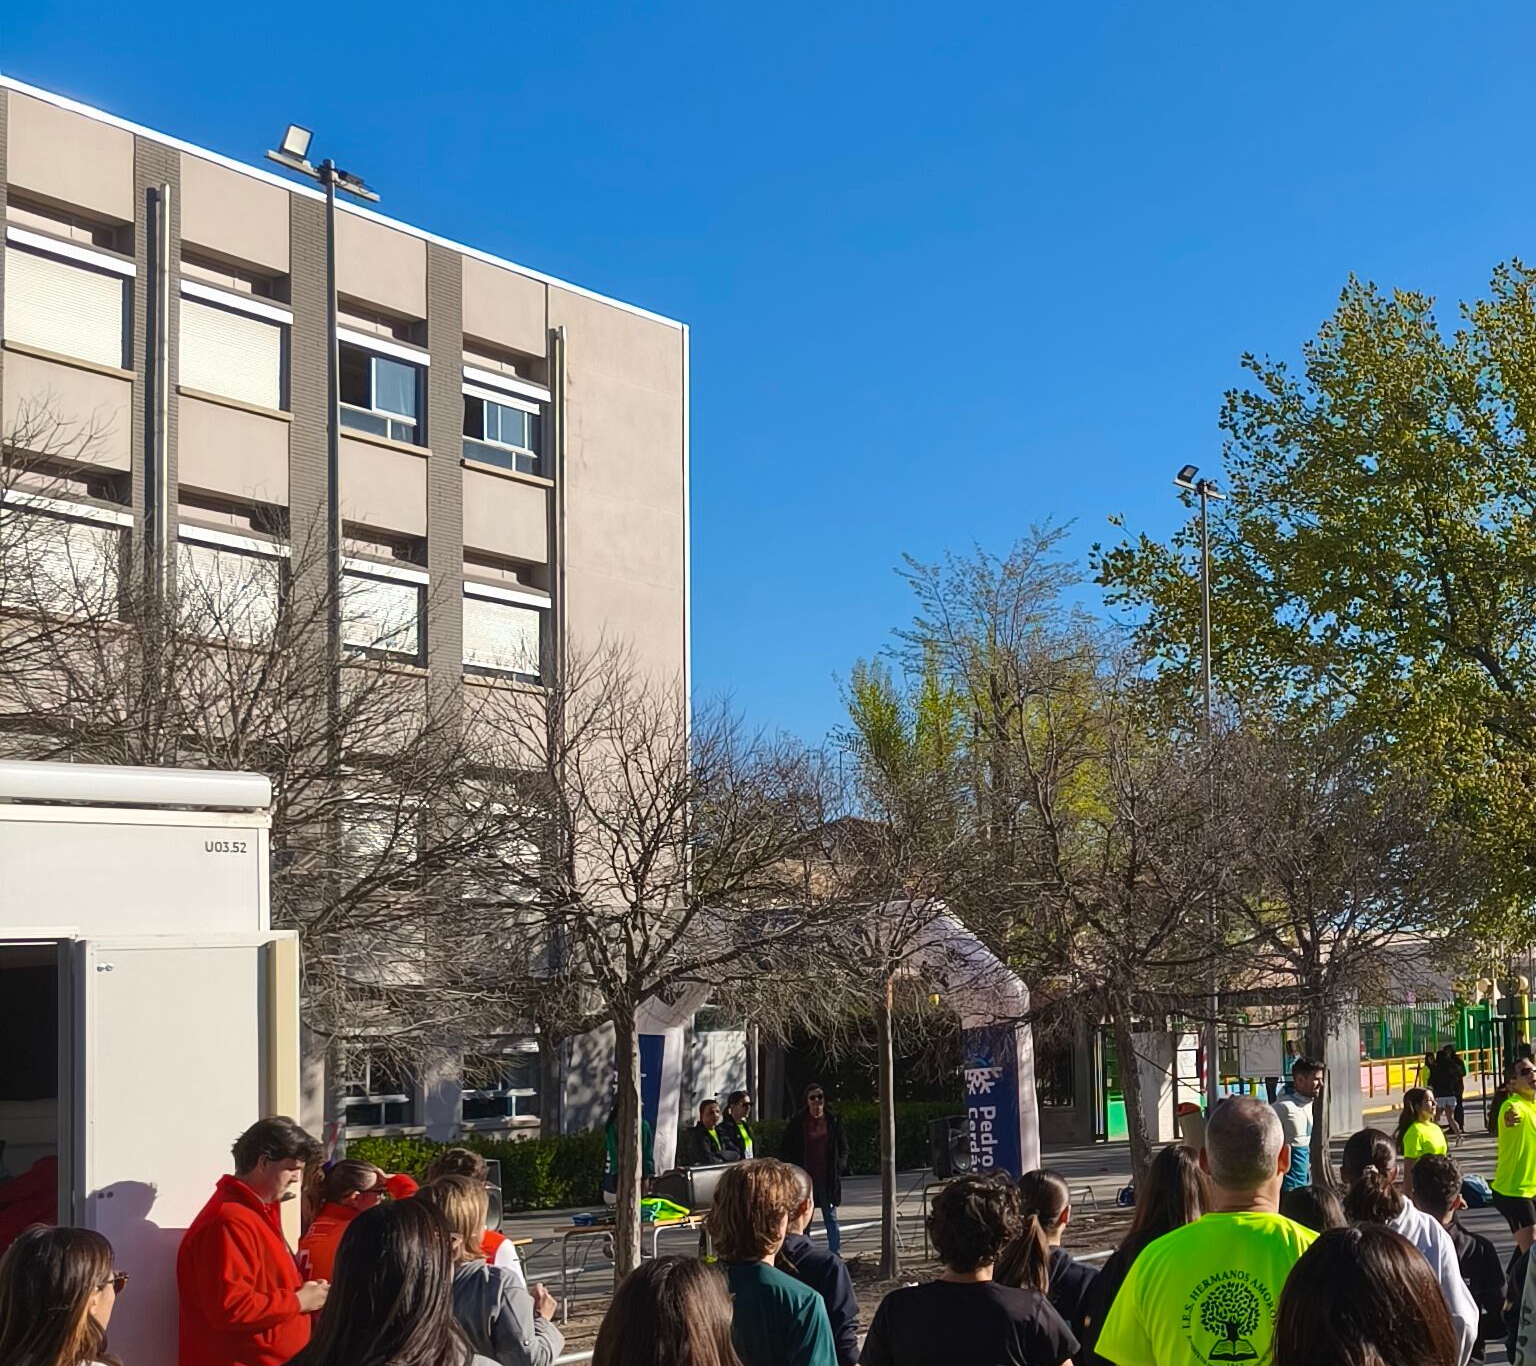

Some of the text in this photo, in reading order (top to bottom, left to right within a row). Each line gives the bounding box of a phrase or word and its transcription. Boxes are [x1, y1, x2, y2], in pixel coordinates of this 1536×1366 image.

[204, 841, 247, 853] U03.52
[968, 1107, 981, 1173] Cerdá
[979, 1105, 999, 1168] Pedro
[1189, 1269, 1251, 1302] HERMANOS
